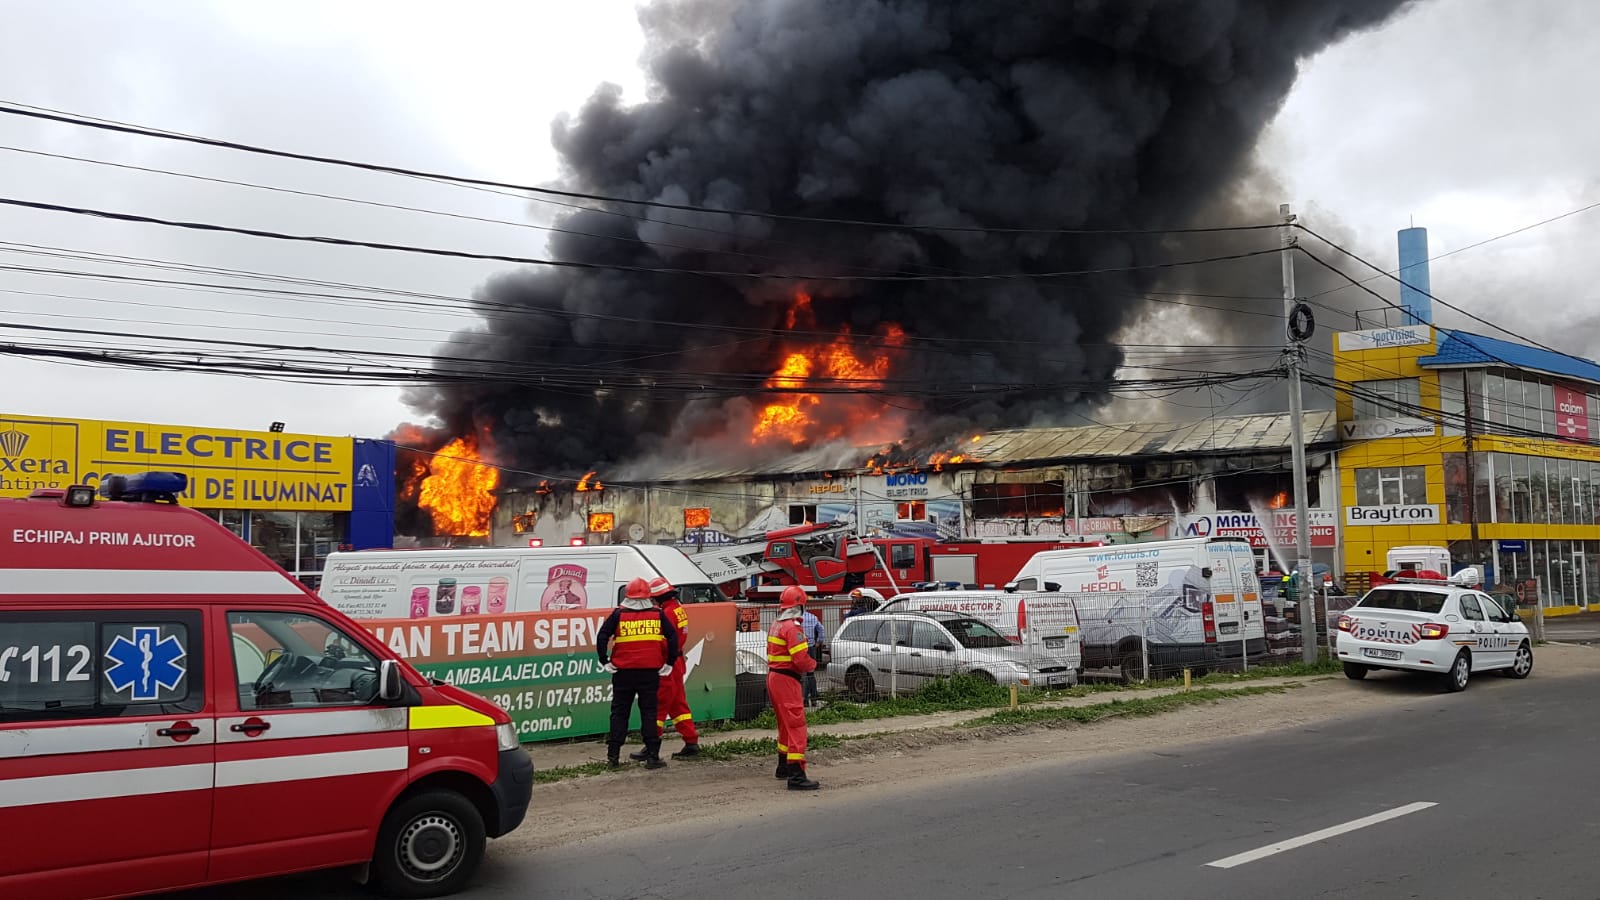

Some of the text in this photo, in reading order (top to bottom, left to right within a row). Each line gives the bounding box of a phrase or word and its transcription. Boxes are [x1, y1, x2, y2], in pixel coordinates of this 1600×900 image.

[106, 428, 332, 463] ELECTRICE
[886, 473, 928, 487] MONO
[206, 478, 234, 500] DE
[241, 479, 348, 503] ILUMINAT
[808, 484, 845, 494] HEPOL
[886, 488, 929, 497] ELECTRIC
[1351, 506, 1433, 522] Braytron
[13, 529, 196, 547] ECHIPAJ PRIM AJUTOR
[1220, 529, 1265, 538] PRODUS
[552, 567, 583, 580] Dinadi
[1081, 581, 1125, 592] HEPOL
[960, 603, 994, 611] SECTOR
[442, 619, 524, 656] TEAM
[533, 616, 604, 650] SERV
[620, 628, 661, 636] SMURD
[21, 644, 91, 683] 112
[443, 661, 564, 686] AMBALAJELOR
[567, 659, 593, 676] DIN
[513, 714, 572, 735] .com.ro
